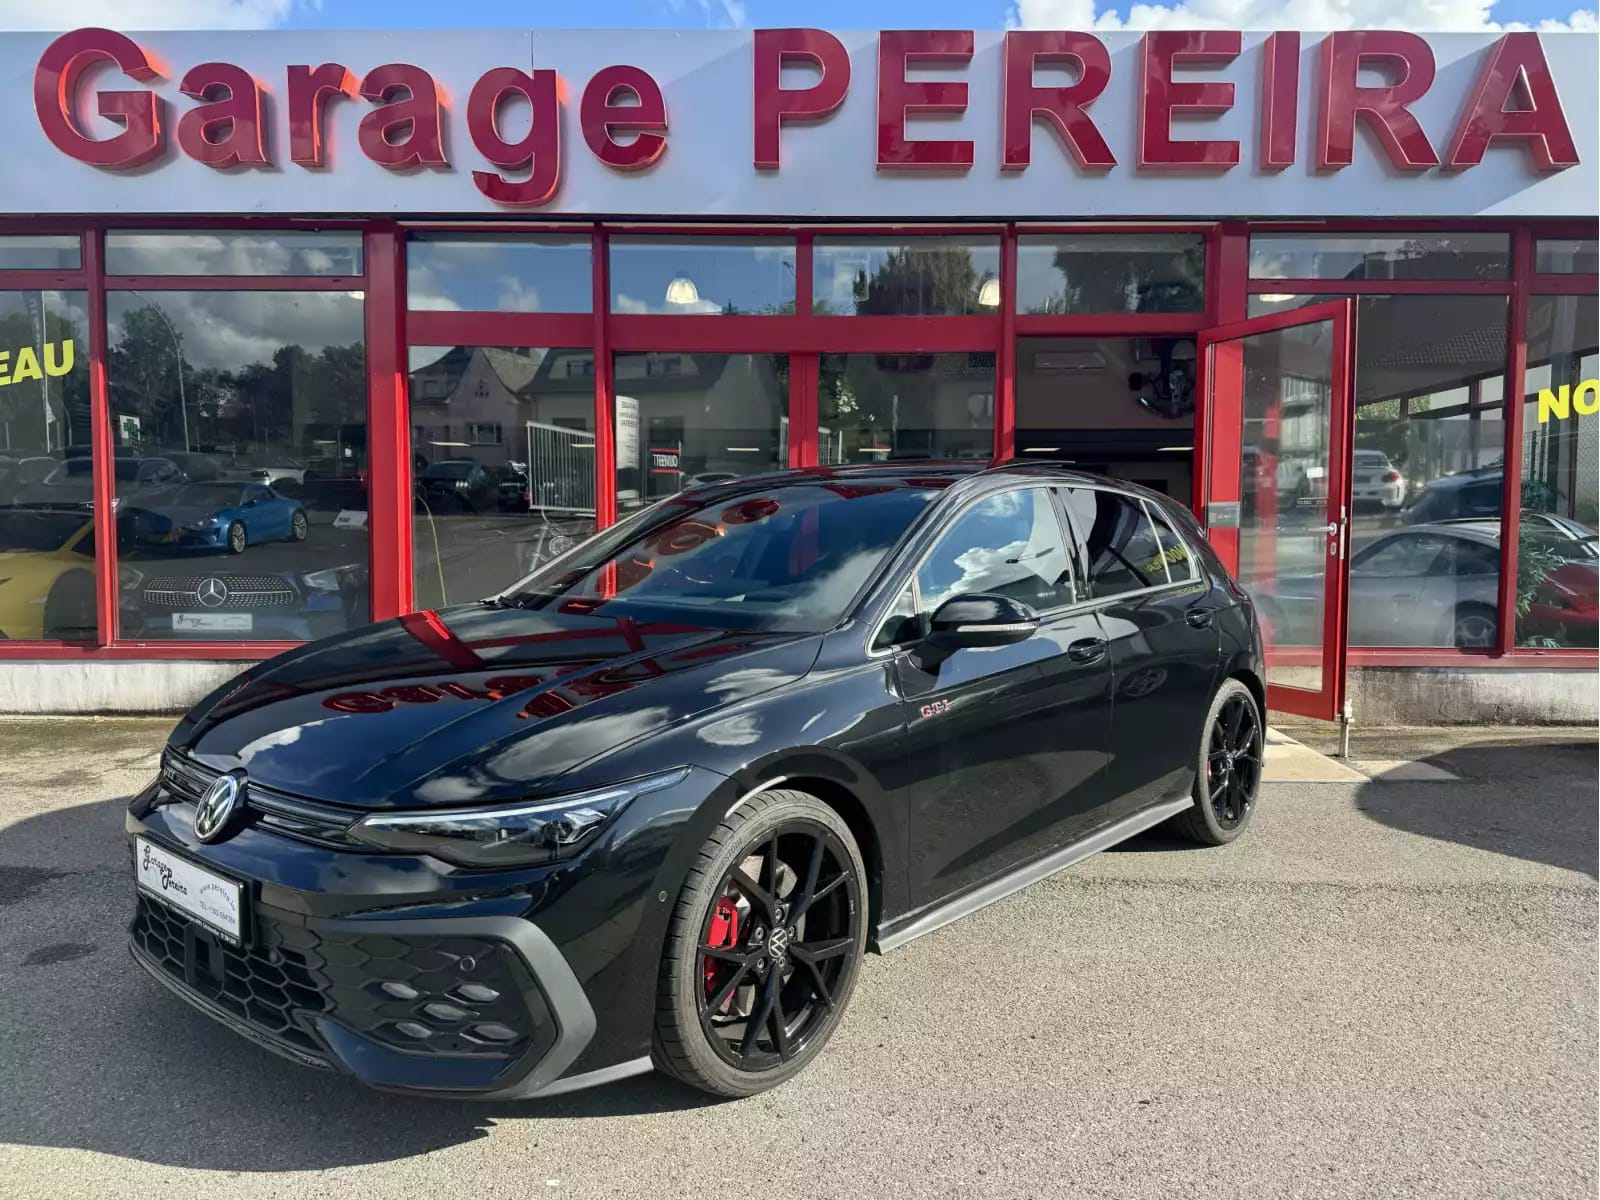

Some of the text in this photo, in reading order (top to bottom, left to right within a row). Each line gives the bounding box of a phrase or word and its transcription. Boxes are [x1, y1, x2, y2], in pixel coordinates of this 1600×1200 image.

[34, 28, 1578, 207] Garage PEREIRA
[1538, 378, 1600, 423] NO
[920, 699, 951, 718] GTI
[143, 845, 168, 876] Garage
[162, 868, 188, 896] Pereira
